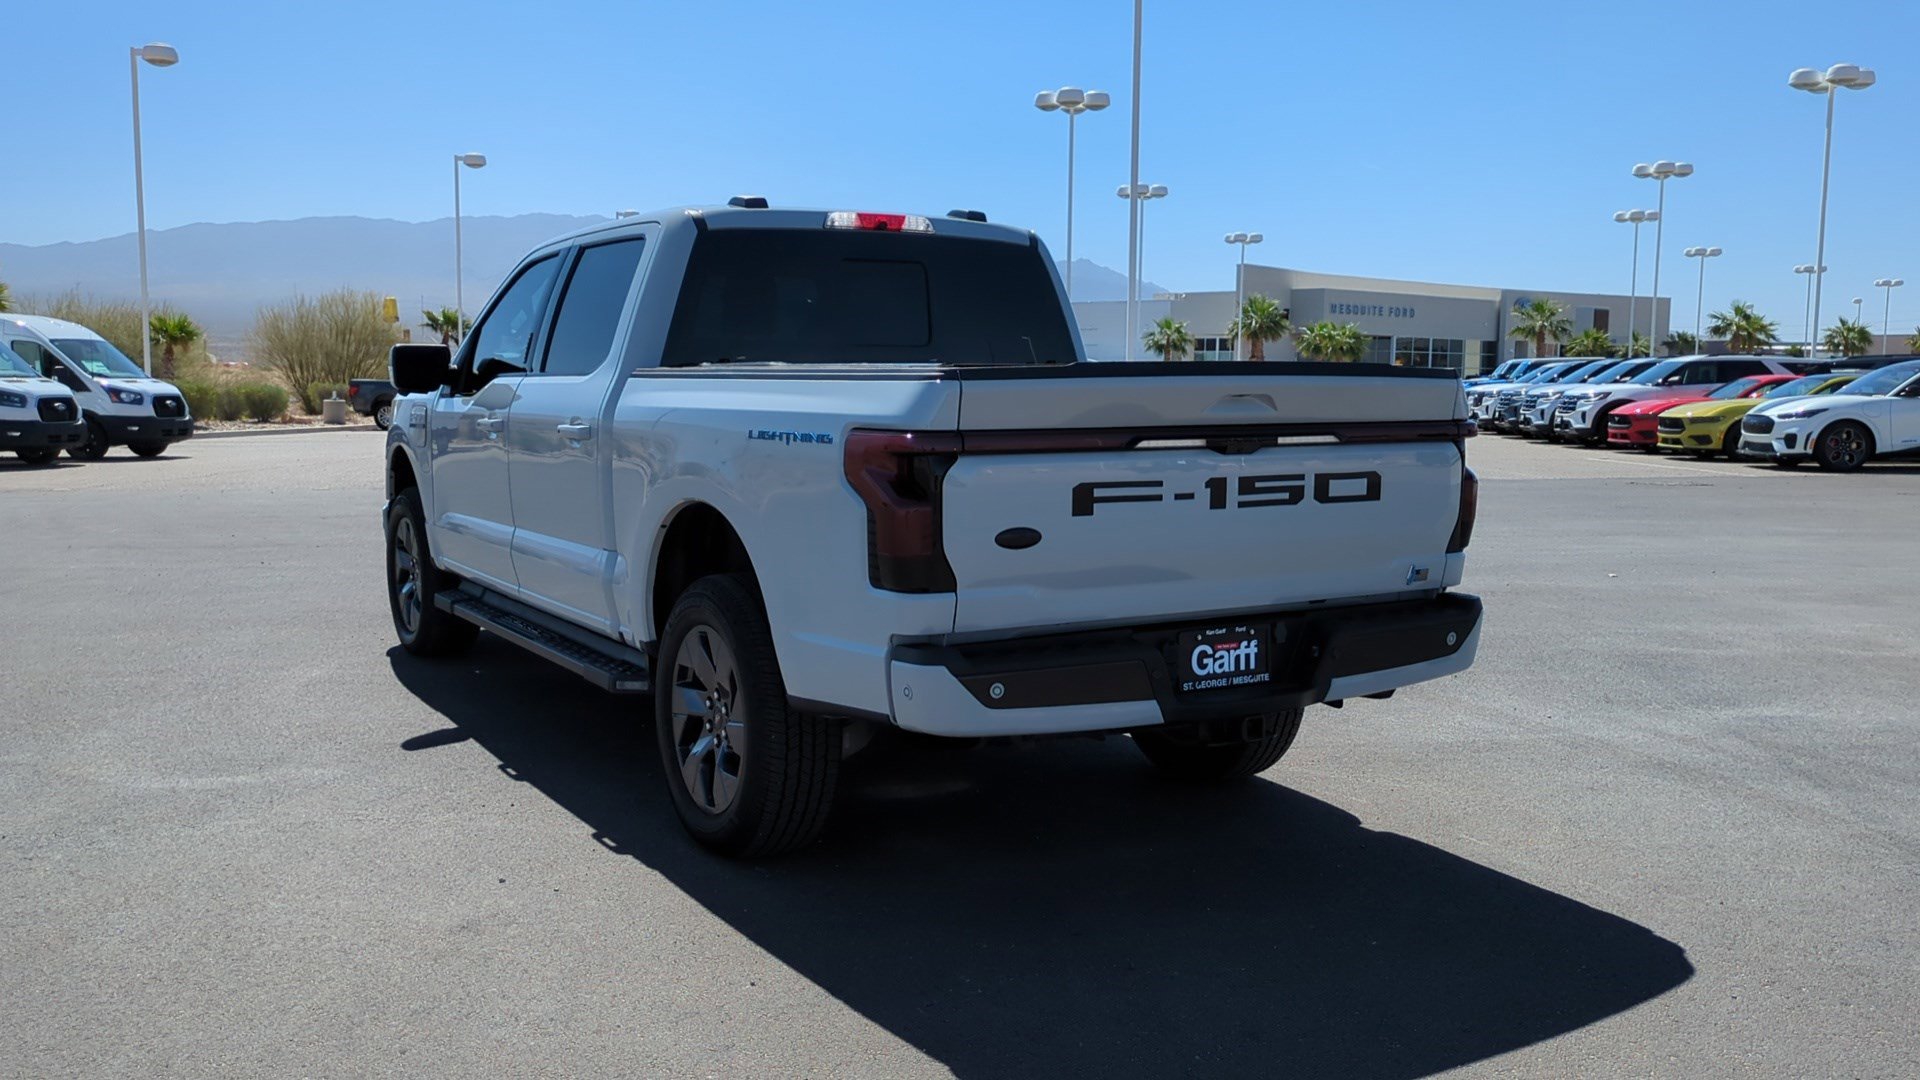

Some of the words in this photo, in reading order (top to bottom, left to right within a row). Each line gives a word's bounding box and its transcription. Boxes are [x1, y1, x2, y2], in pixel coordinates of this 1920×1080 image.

[1330, 303, 1384, 317] MESQUITE
[1388, 306, 1416, 319] FORD
[748, 429, 834, 446] LIGHTNING
[1072, 470, 1382, 517] F-150
[1191, 639, 1258, 676] Garff
[1183, 682, 1194, 691] ST.
[1195, 678, 1228, 690] GEORGE
[1232, 673, 1270, 685] MESQUITE
